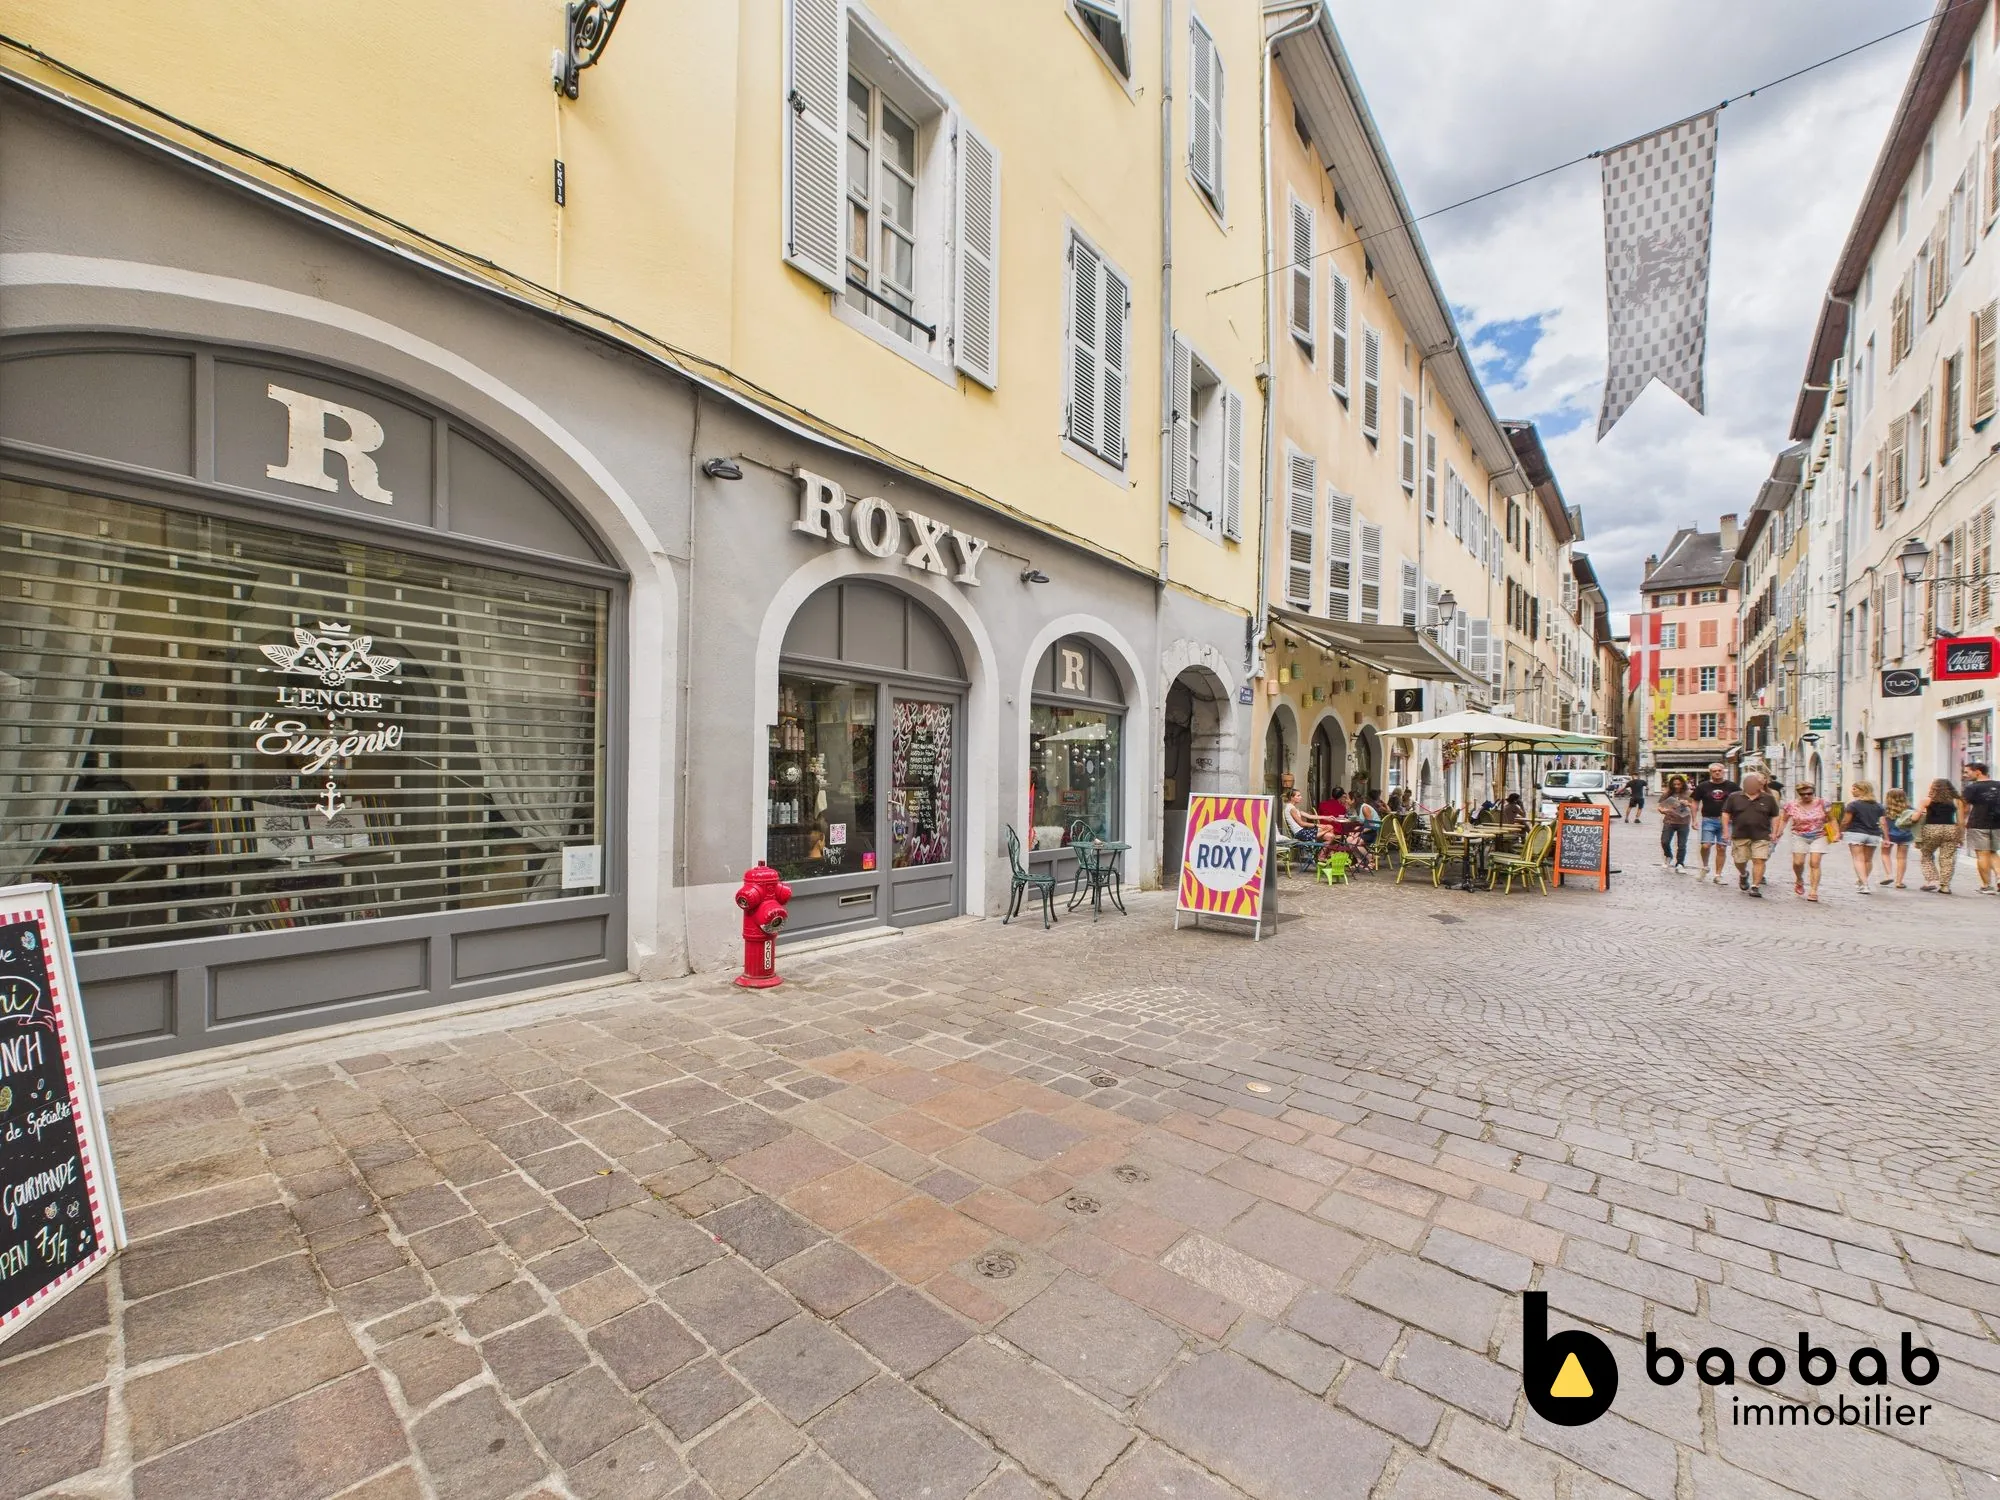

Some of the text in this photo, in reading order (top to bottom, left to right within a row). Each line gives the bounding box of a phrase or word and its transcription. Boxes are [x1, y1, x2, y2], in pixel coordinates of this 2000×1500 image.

[266, 383, 393, 506] R
[791, 468, 988, 587] ROXY
[1061, 648, 1086, 692] R
[1948, 663, 1986, 672] LAURE
[276, 686, 382, 709] L'ENCRE
[1197, 843, 1253, 873] ROXY
[0, 1031, 43, 1079] NCH
